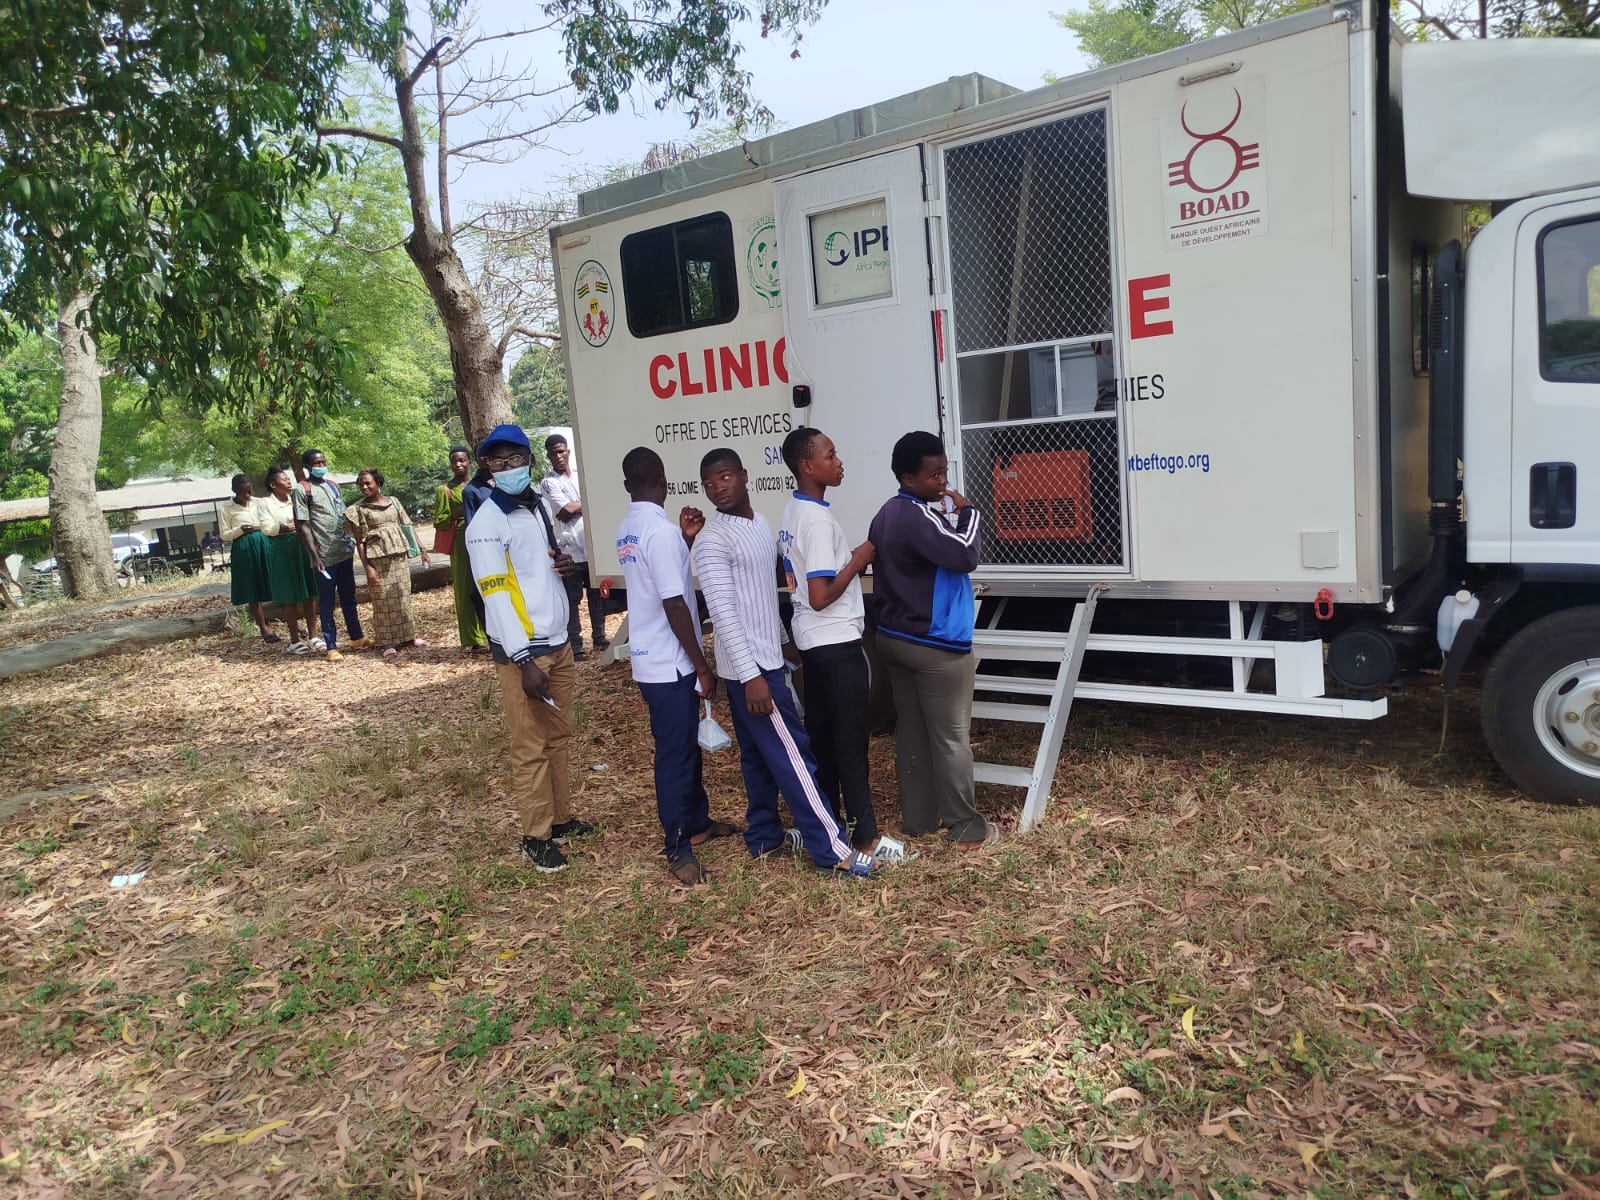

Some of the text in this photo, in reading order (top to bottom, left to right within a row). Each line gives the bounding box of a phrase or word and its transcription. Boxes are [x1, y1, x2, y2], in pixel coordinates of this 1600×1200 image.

[1180, 190, 1250, 221] BOAD
[1170, 217, 1261, 240] BANQUE OUEST AFRICAINE
[1181, 239, 1192, 247] DE
[1128, 273, 1173, 340] E
[655, 412, 792, 443] OFFRE DE SERVICES
[677, 481, 699, 495] LOME
[755, 476, 784, 493] (00228)
[785, 475, 795, 489] 92
